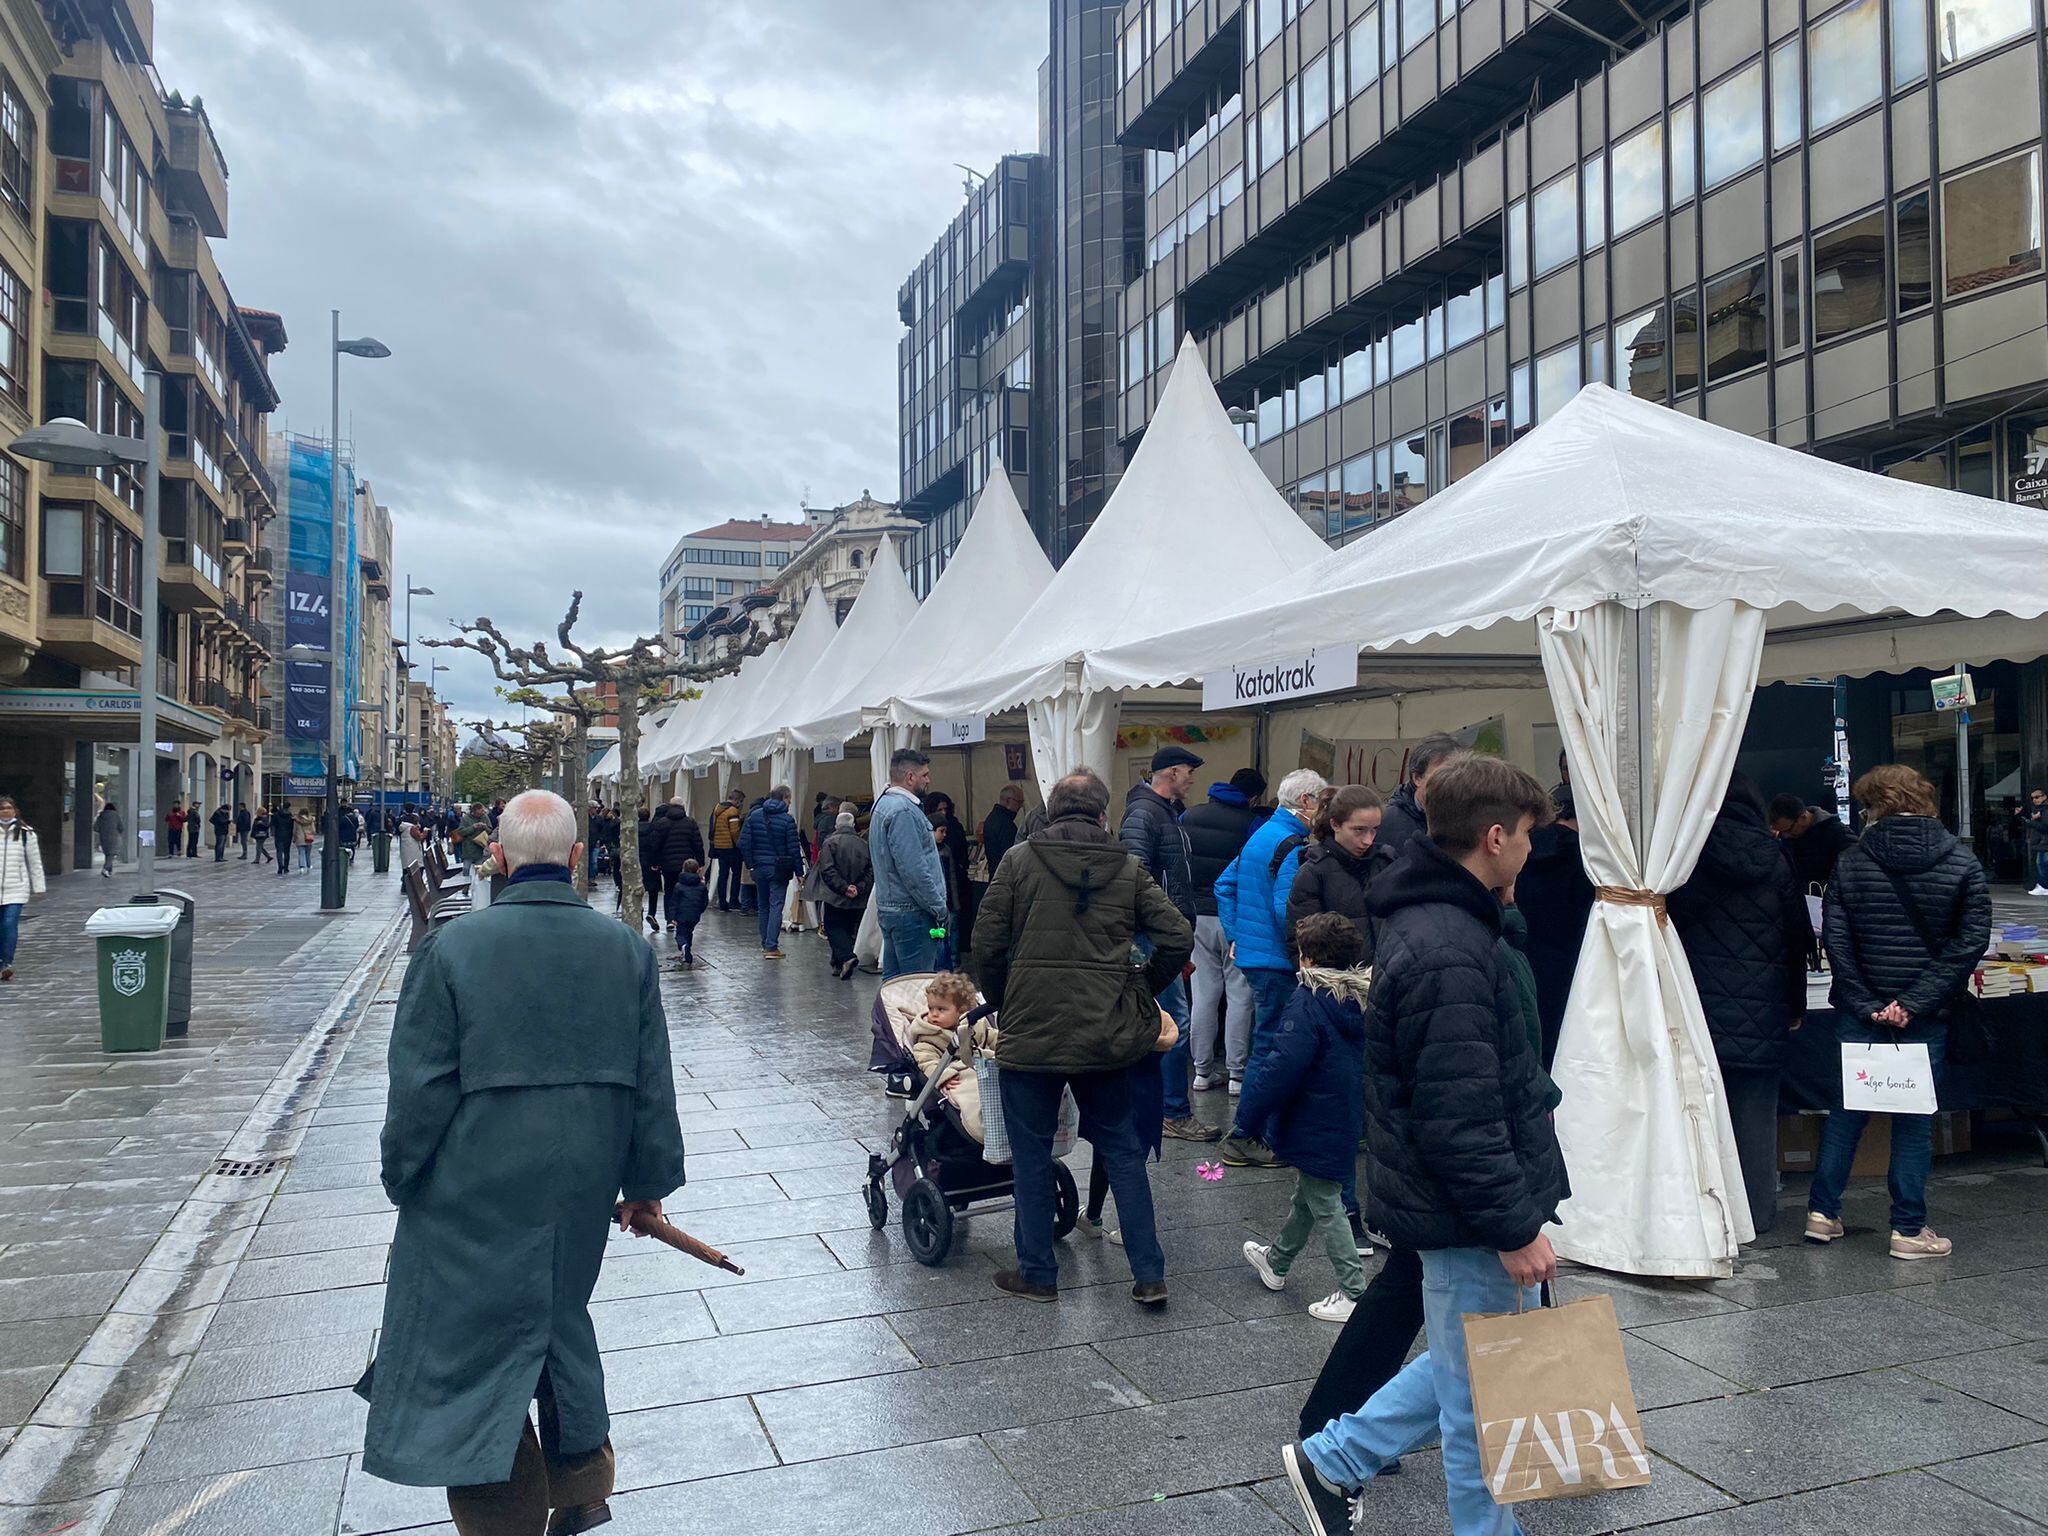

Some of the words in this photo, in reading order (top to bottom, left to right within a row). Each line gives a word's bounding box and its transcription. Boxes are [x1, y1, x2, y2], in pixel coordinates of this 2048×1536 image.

[2016, 493, 2041, 503] Banca
[1236, 659, 1315, 699] Katakrak
[99, 699, 132, 709] CARLOS
[1863, 1075, 1884, 1093] algo
[1886, 1076, 1917, 1090] bonito
[1481, 1401, 1651, 1496] ZARA
